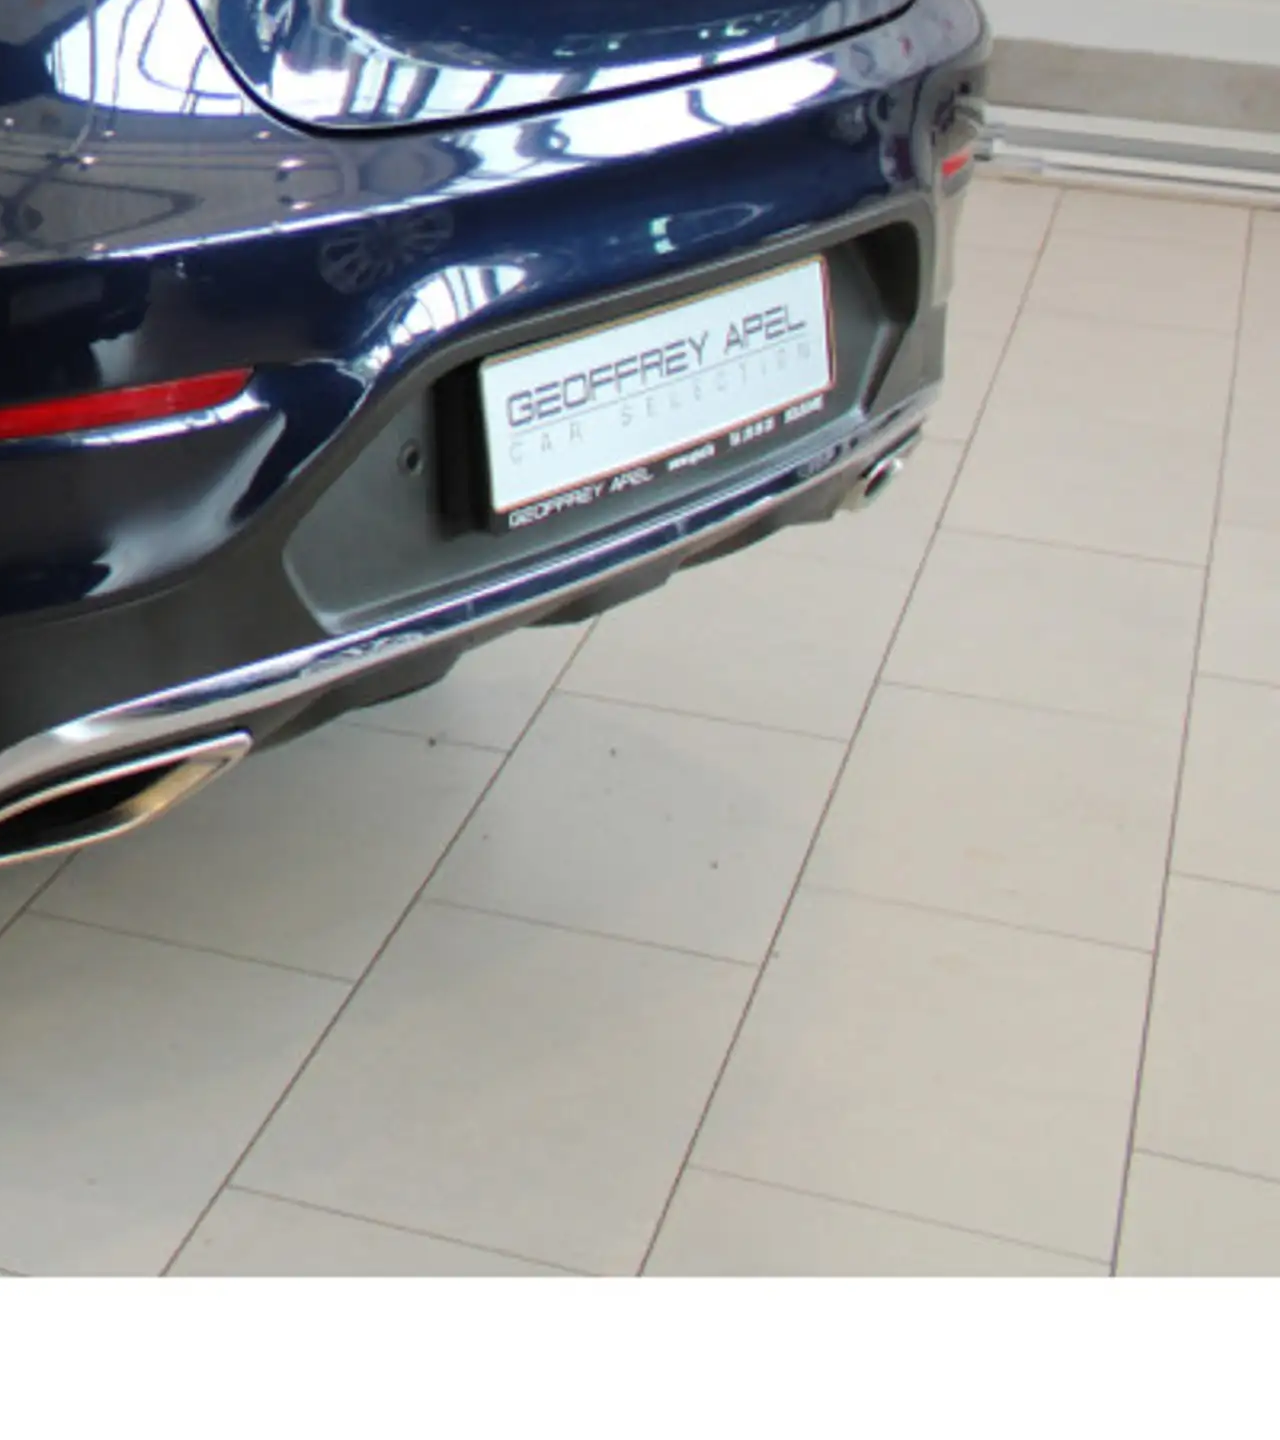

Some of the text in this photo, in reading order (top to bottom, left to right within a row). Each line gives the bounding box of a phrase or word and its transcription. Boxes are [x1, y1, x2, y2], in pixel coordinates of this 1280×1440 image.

[506, 330, 709, 428] GEOFFREY
[724, 305, 807, 356] APEL
[509, 420, 584, 466] CAR
[619, 340, 812, 428] SELECTION
[508, 466, 655, 529] GEOFFREY APEL
